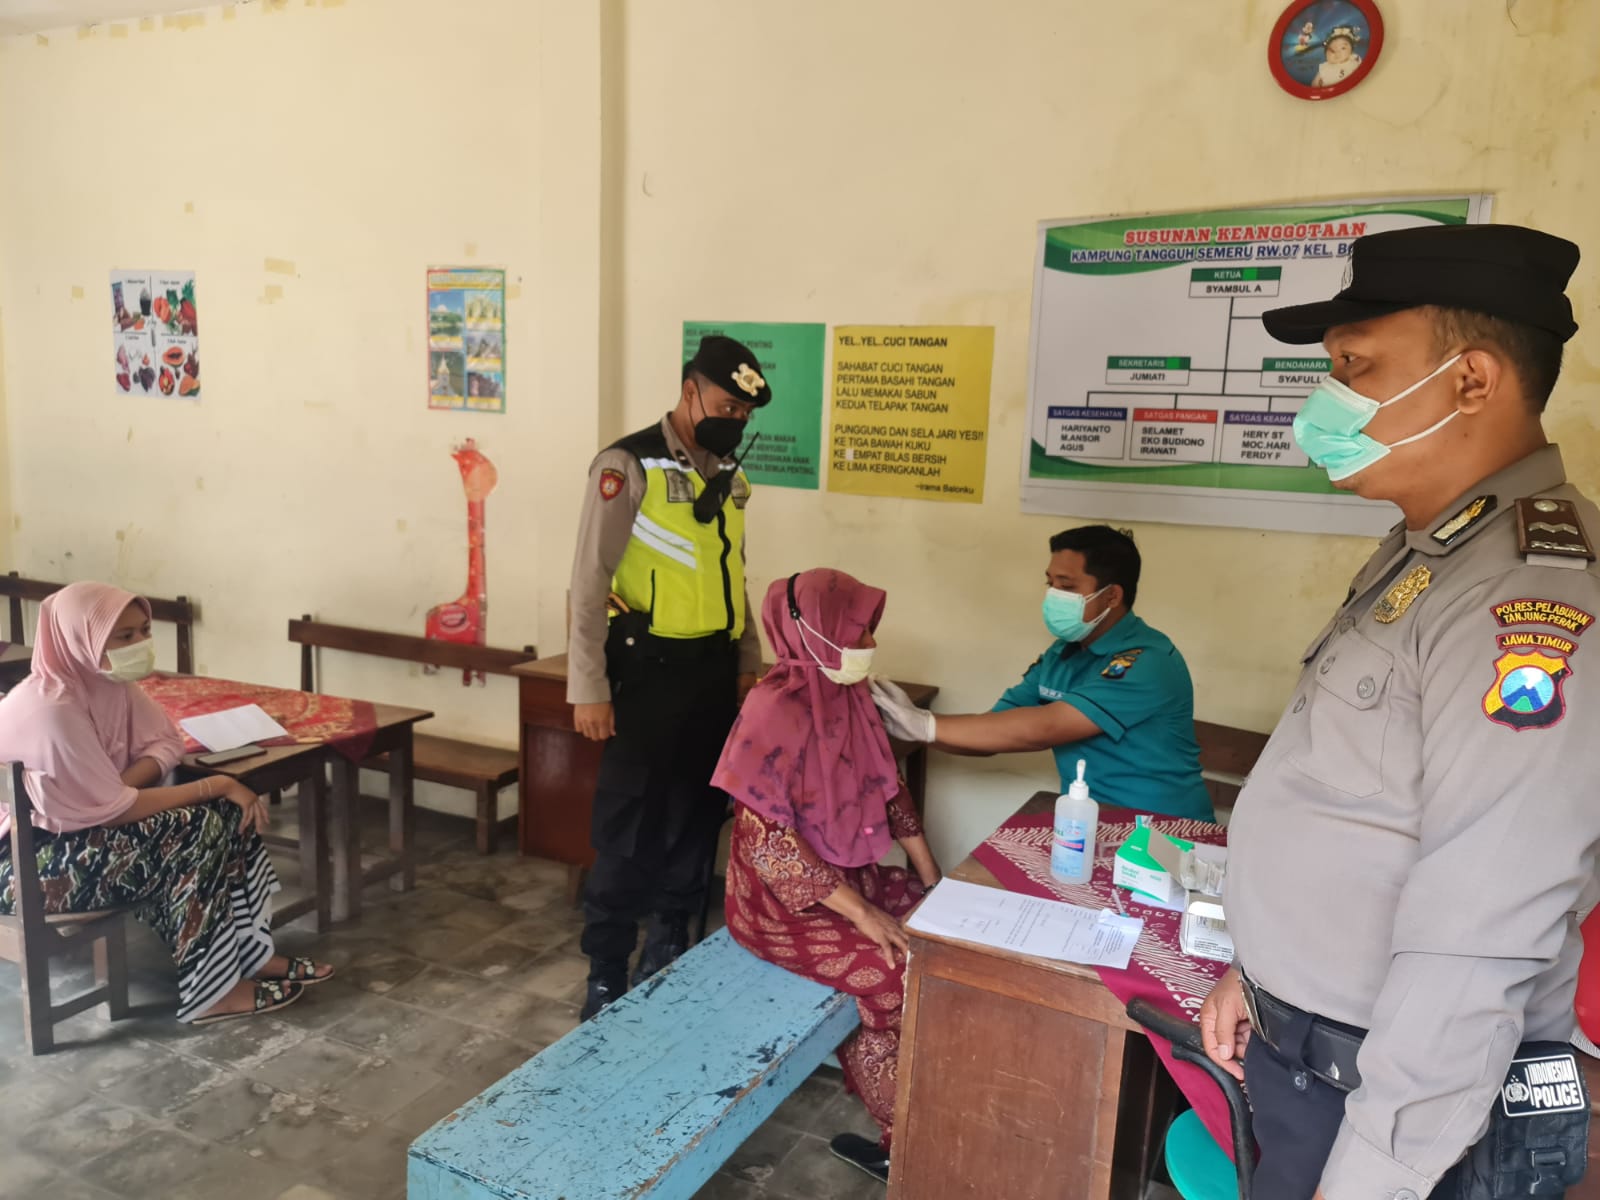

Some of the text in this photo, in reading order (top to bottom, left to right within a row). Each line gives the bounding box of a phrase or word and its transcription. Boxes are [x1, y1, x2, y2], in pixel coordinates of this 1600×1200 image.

[1125, 223, 1366, 244] SUSUNAN KEANGGOTAAN
[1071, 249, 1131, 262] KAMPUNG
[1135, 247, 1194, 260] TANGGUH
[1198, 245, 1252, 259] SEMERU
[1256, 243, 1300, 257] RW.07
[1303, 242, 1332, 256] KEL.
[1214, 270, 1242, 279] KETUA
[1254, 284, 1262, 292] A
[909, 337, 947, 347] TANGAN
[837, 362, 943, 374] SAHABAT CUCI TANGAN
[1118, 359, 1165, 367] SEKRETARIS
[1275, 361, 1327, 369] BENDAHARA
[837, 374, 955, 387] PERTAMA BASAHI TANGAN
[1130, 373, 1165, 381] JUMIATI
[836, 387, 937, 399] LALU MEMAKAI SABUN
[836, 400, 948, 413] KEDUA TELAPAK TANGAN
[1053, 409, 1123, 418] SATGAS KESEHATAN
[1144, 411, 1208, 420] SATGAS PANGAN
[1229, 414, 1262, 422] SATGAS
[835, 424, 887, 436] PUNGGUNG
[889, 426, 909, 437] DAN
[911, 428, 935, 438] SELA
[936, 429, 956, 439] JARI
[1061, 425, 1111, 433] HARIYANTO
[1142, 427, 1184, 435] SELAMET
[1243, 430, 1284, 439] HERY ST
[834, 437, 931, 451] KE TIGA BAWAH KUKU
[1141, 437, 1205, 446] EKO BUDIONO
[1140, 447, 1177, 455] IRAWATI
[1241, 451, 1281, 460] FERDY F
[833, 449, 947, 465] KE EMPAT BILAS BERSIH
[833, 461, 941, 477] KE LIMA KERINGKANLAH
[1495, 602, 1591, 626] POLRES PELABUHAN
[1502, 612, 1581, 631] TANJUNG PERAK
[1502, 634, 1573, 653] JAWA TIMUR
[1533, 1082, 1580, 1108] POLICE
